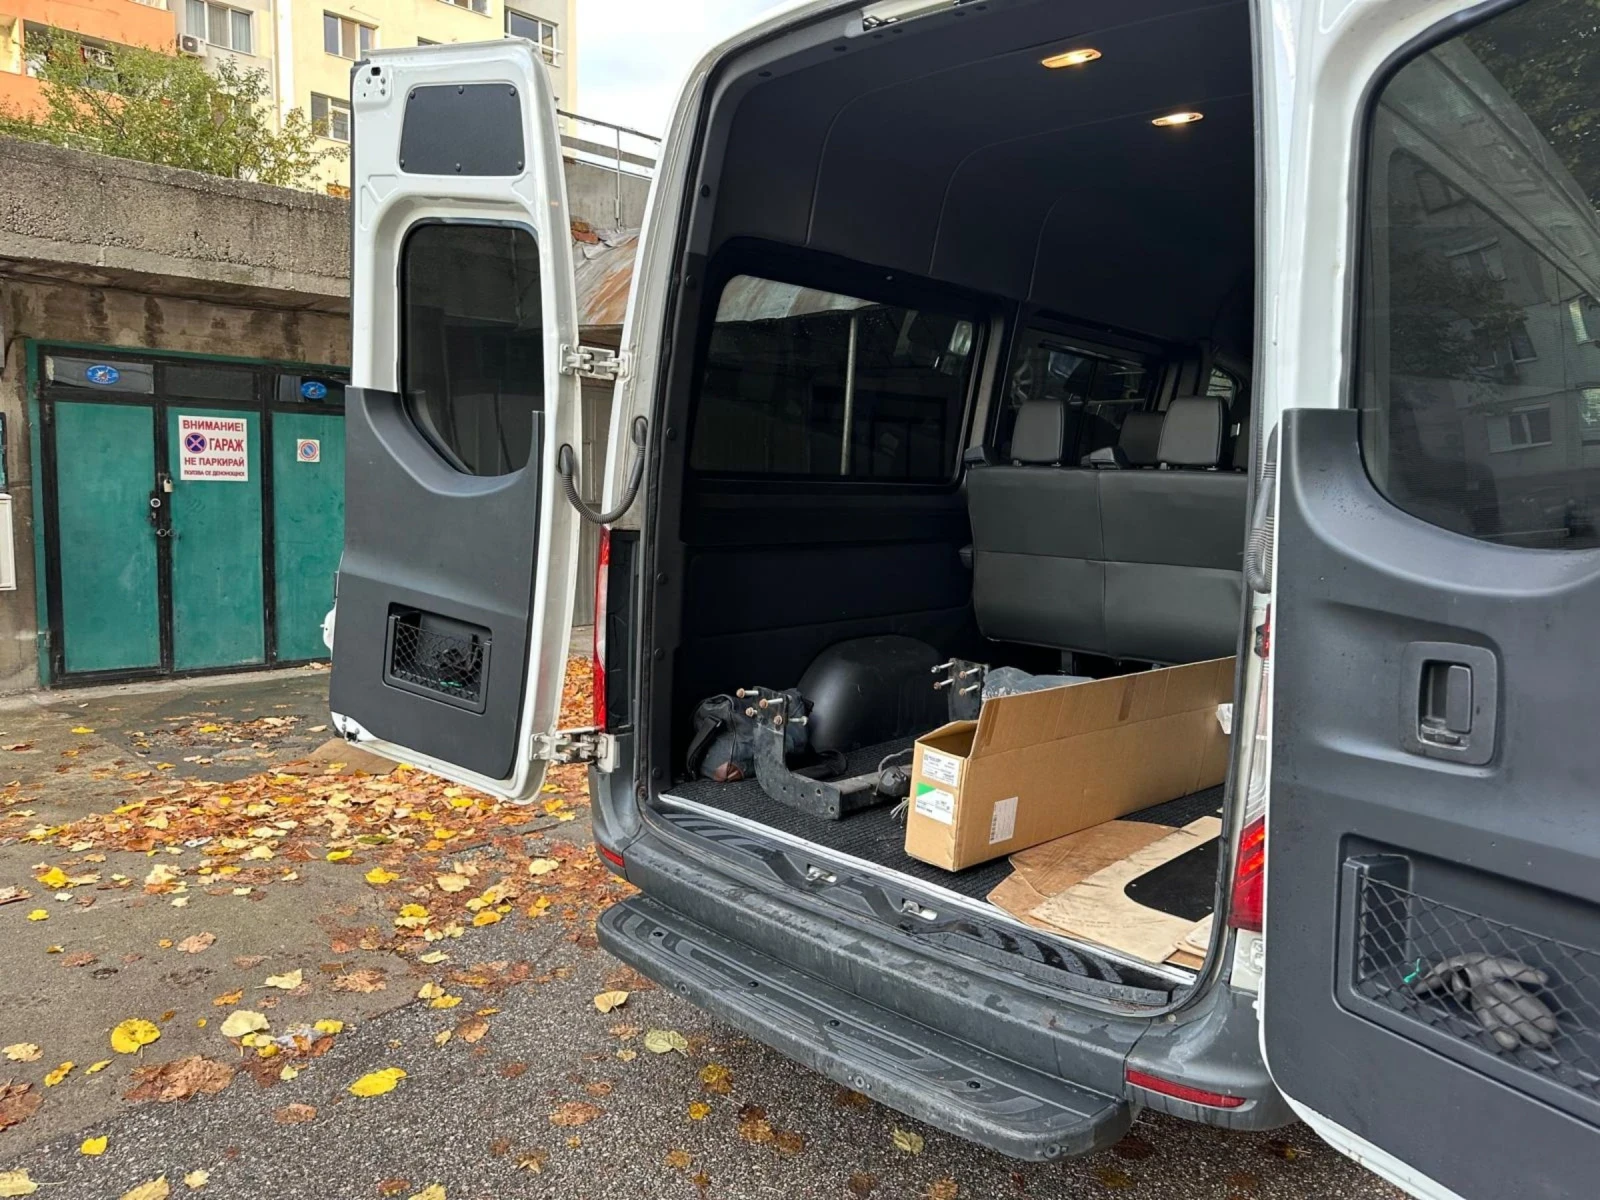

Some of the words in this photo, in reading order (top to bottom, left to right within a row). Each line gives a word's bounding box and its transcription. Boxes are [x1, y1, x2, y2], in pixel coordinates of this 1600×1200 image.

[183, 420, 244, 432] ВНИМАНИЕ!
[209, 438, 244, 452] ГАРАЖ
[184, 457, 197, 466] НЕ
[199, 457, 245, 467] ПАРКИРАЙ
